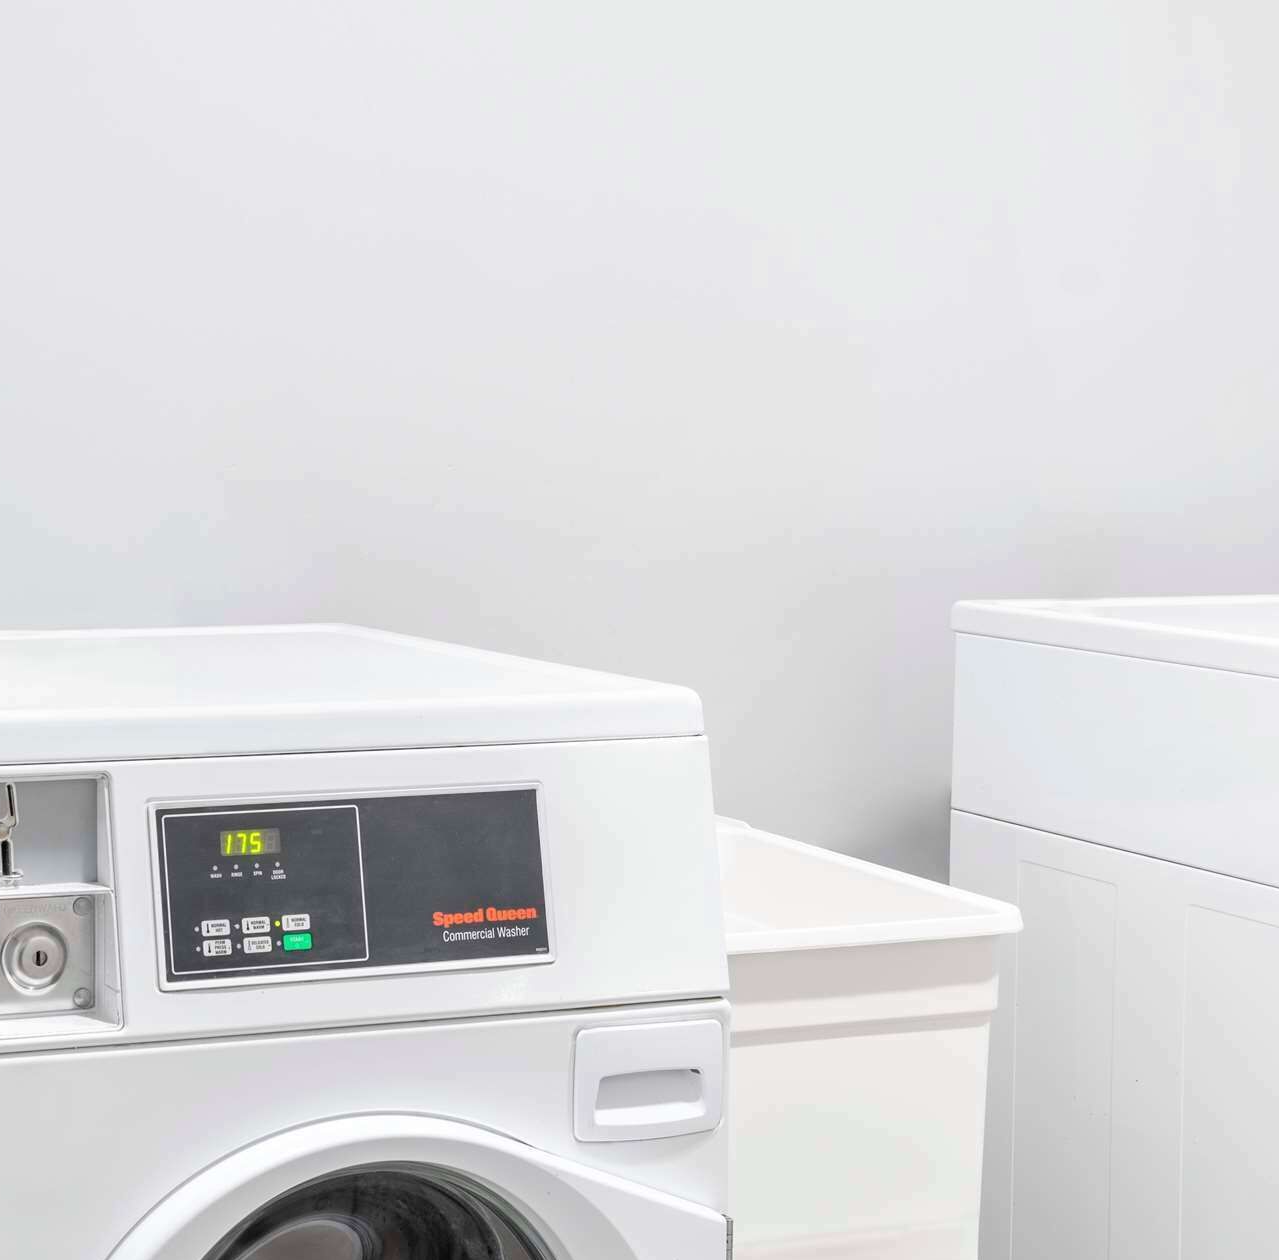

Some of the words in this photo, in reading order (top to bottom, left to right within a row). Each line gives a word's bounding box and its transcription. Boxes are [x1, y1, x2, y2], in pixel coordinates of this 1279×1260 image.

[226, 832, 261, 855] 175
[432, 908, 484, 928] Speed
[486, 907, 537, 922] Queen
[443, 927, 495, 942] Commercial
[497, 925, 530, 938] Washer
